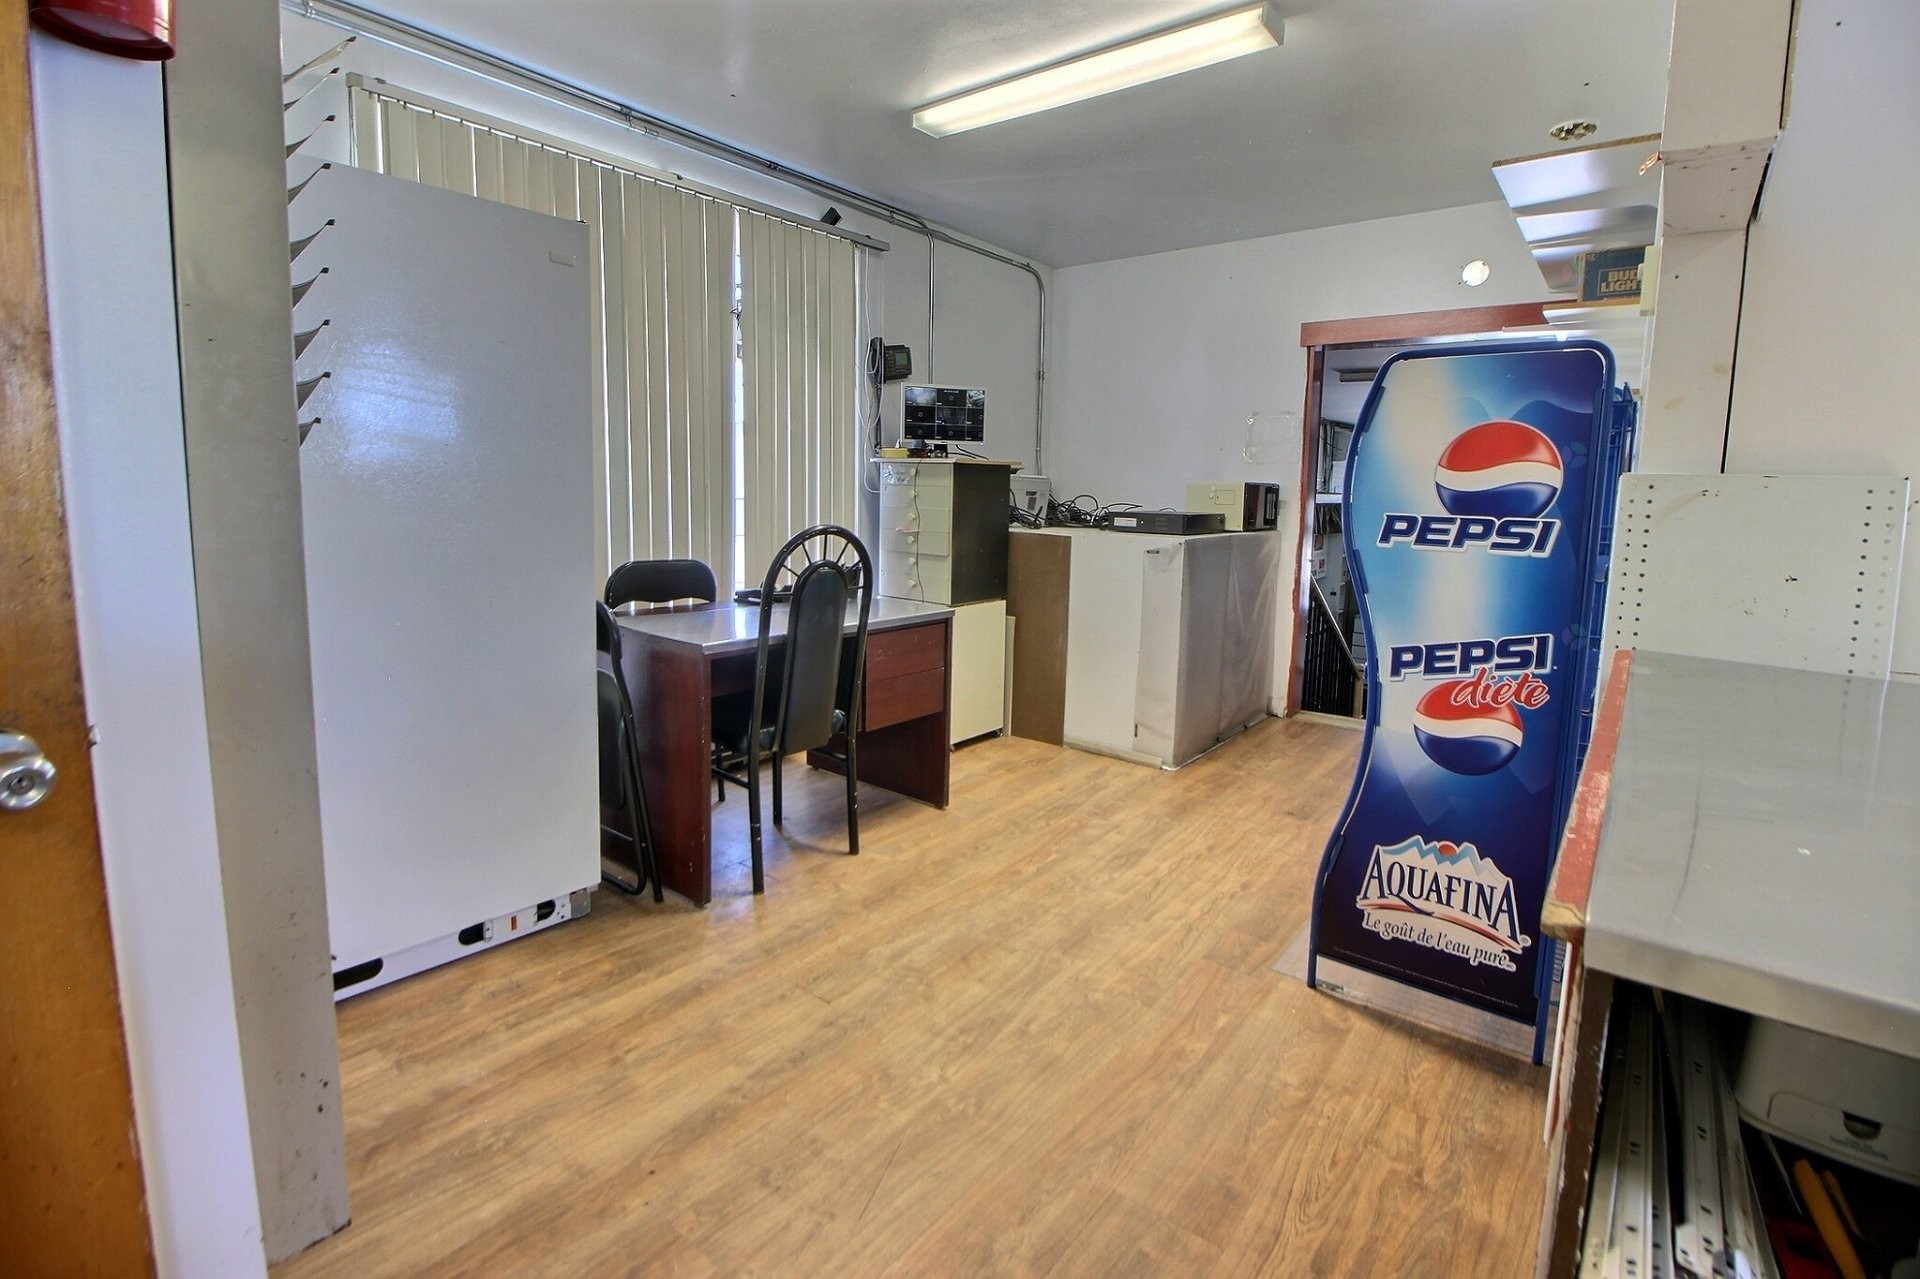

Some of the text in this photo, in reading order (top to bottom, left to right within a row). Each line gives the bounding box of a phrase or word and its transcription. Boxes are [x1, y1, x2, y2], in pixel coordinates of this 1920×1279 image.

[1601, 280, 1639, 293] LIGH
[1377, 513, 1560, 557] PEPSI
[1389, 633, 1554, 681] PEPSI
[1452, 666, 1549, 709] diète
[1360, 846, 1521, 945] AQUAFINA
[1364, 912, 1507, 966] Le goût de l'eau pure
